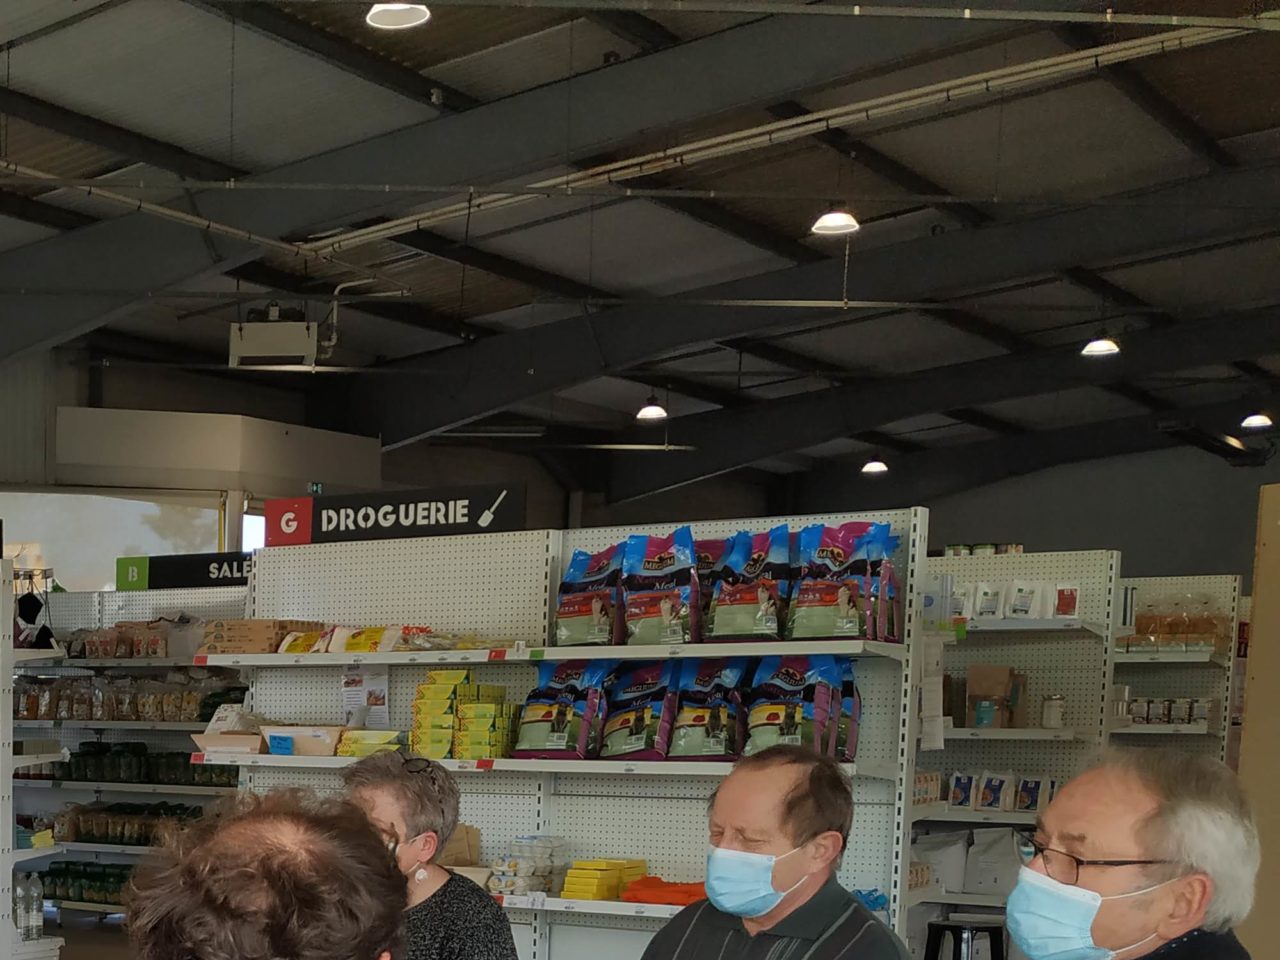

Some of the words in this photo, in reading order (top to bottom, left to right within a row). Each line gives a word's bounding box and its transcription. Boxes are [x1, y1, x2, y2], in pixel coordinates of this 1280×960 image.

[280, 512, 298, 533] G
[321, 499, 470, 532] DROGUERIE
[128, 566, 138, 582] B
